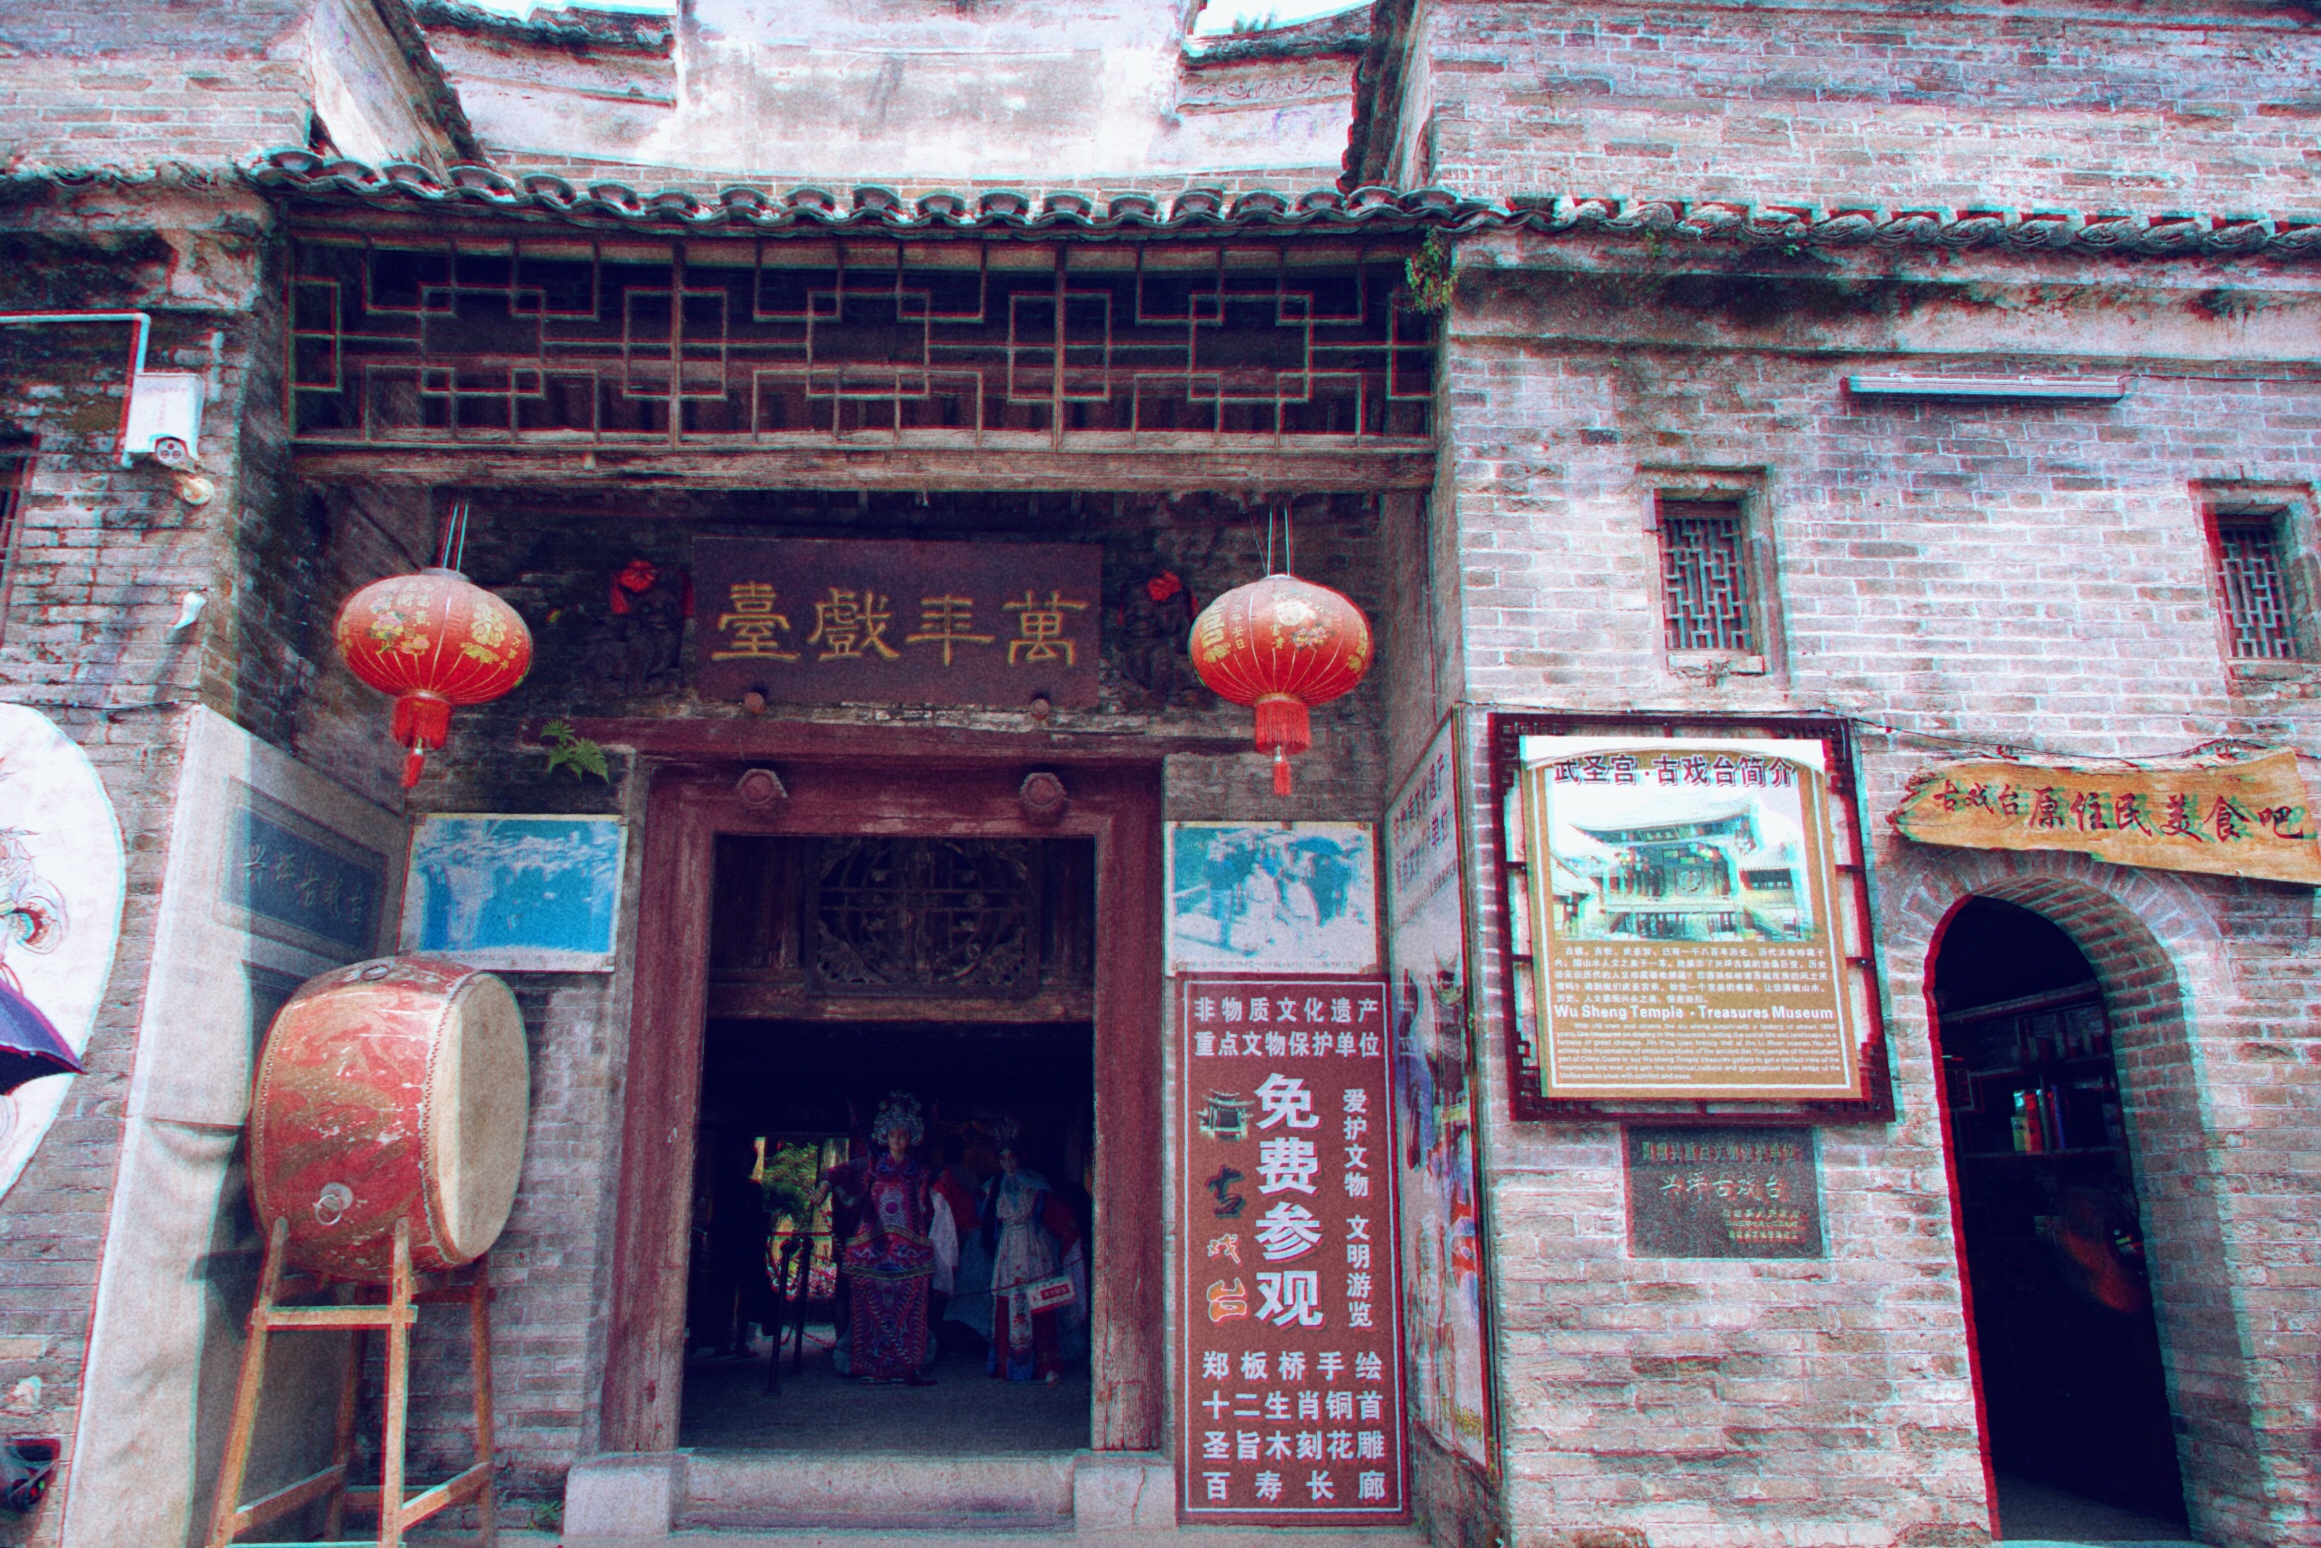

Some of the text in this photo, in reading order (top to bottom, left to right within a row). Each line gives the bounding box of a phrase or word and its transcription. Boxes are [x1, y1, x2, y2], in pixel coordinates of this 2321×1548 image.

[1932, 779, 2305, 842] 古戏台原住民美食吧
[1194, 996, 1378, 1024] 非物质文化遗产
[1554, 1005, 1833, 1021] Wu Sheng Temple Treasures Museum
[1194, 1030, 1380, 1058] 重点文物保护单位
[1342, 1088, 1369, 1199] 爱护文物
[1254, 1072, 1324, 1328] 免费参观
[1658, 1170, 1783, 1202] 兴坪古戏台
[1204, 1164, 1248, 1323] 古戏台
[1345, 1214, 1373, 1328] 文明游览
[1202, 1350, 1383, 1381] 郑板桥手绘
[1202, 1390, 1385, 1422] 十二生肖铜首
[1202, 1429, 1386, 1460] 圣旨木刻花雕
[1202, 1470, 1386, 1501] 百寿长廊
